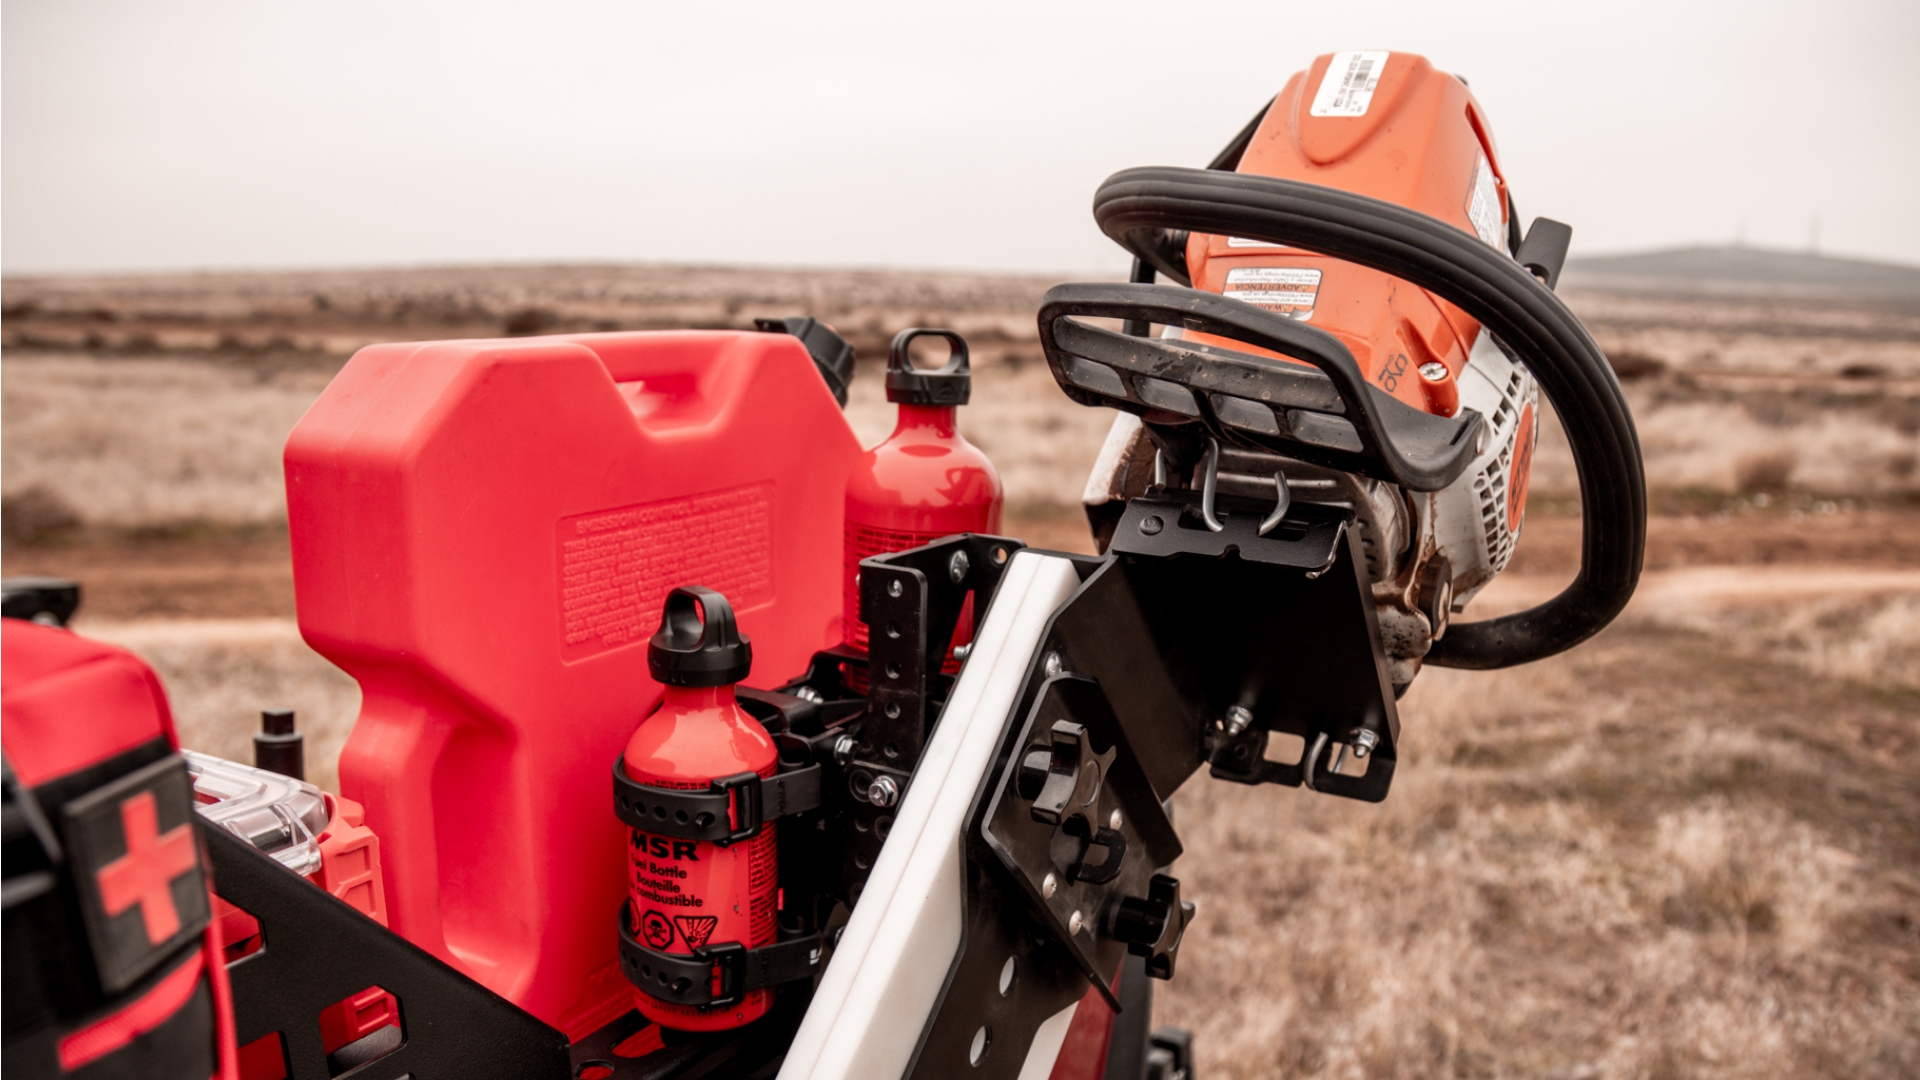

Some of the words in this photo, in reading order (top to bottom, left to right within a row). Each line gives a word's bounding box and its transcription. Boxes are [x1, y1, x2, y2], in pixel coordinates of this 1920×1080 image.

[575, 510, 636, 536] EMISSION
[639, 501, 689, 524] CONTROL
[631, 831, 699, 861] MSR
[632, 853, 646, 871] Fuel
[650, 862, 687, 879] Bottle
[637, 871, 681, 893] Bouteille
[637, 887, 703, 907] combustible
[651, 1001, 676, 1014] SAFETY
